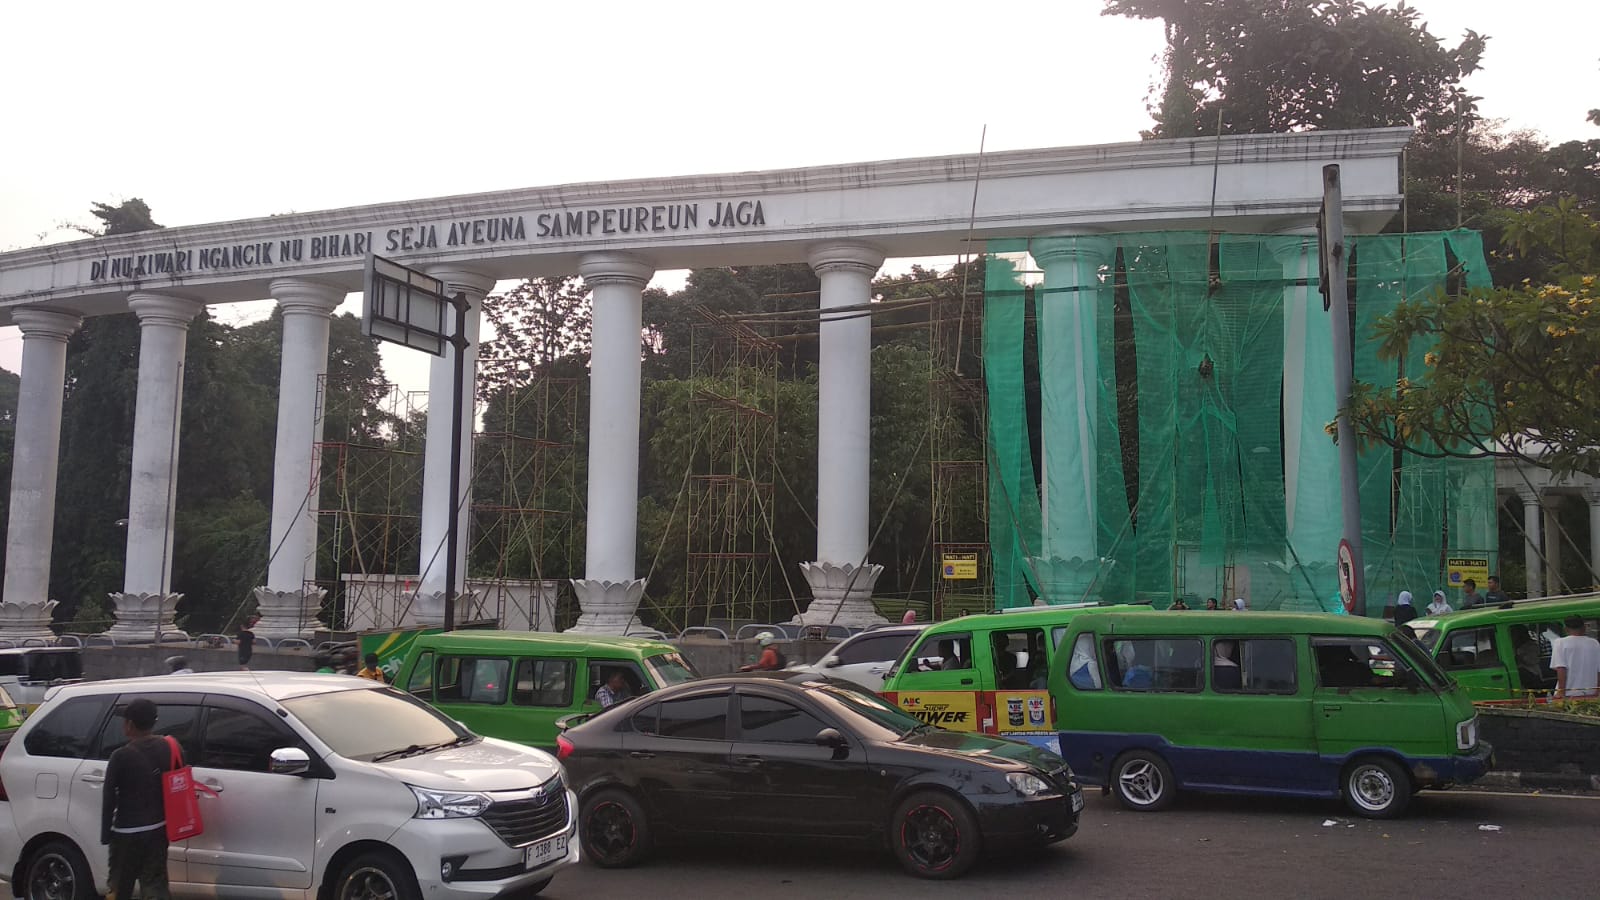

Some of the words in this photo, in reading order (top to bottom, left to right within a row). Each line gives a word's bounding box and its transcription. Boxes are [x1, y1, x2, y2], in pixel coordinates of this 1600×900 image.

[90, 260, 109, 281] DI
[110, 257, 133, 279] NU
[137, 249, 193, 276] KIWARI
[199, 241, 273, 269] NGANCIK
[280, 239, 303, 262] NU
[310, 231, 372, 259] BIHARI
[385, 224, 437, 252] SEJA
[447, 215, 526, 246] AYEUNA
[536, 203, 698, 237] SAMPEUREUN
[709, 200, 766, 228] JAGA
